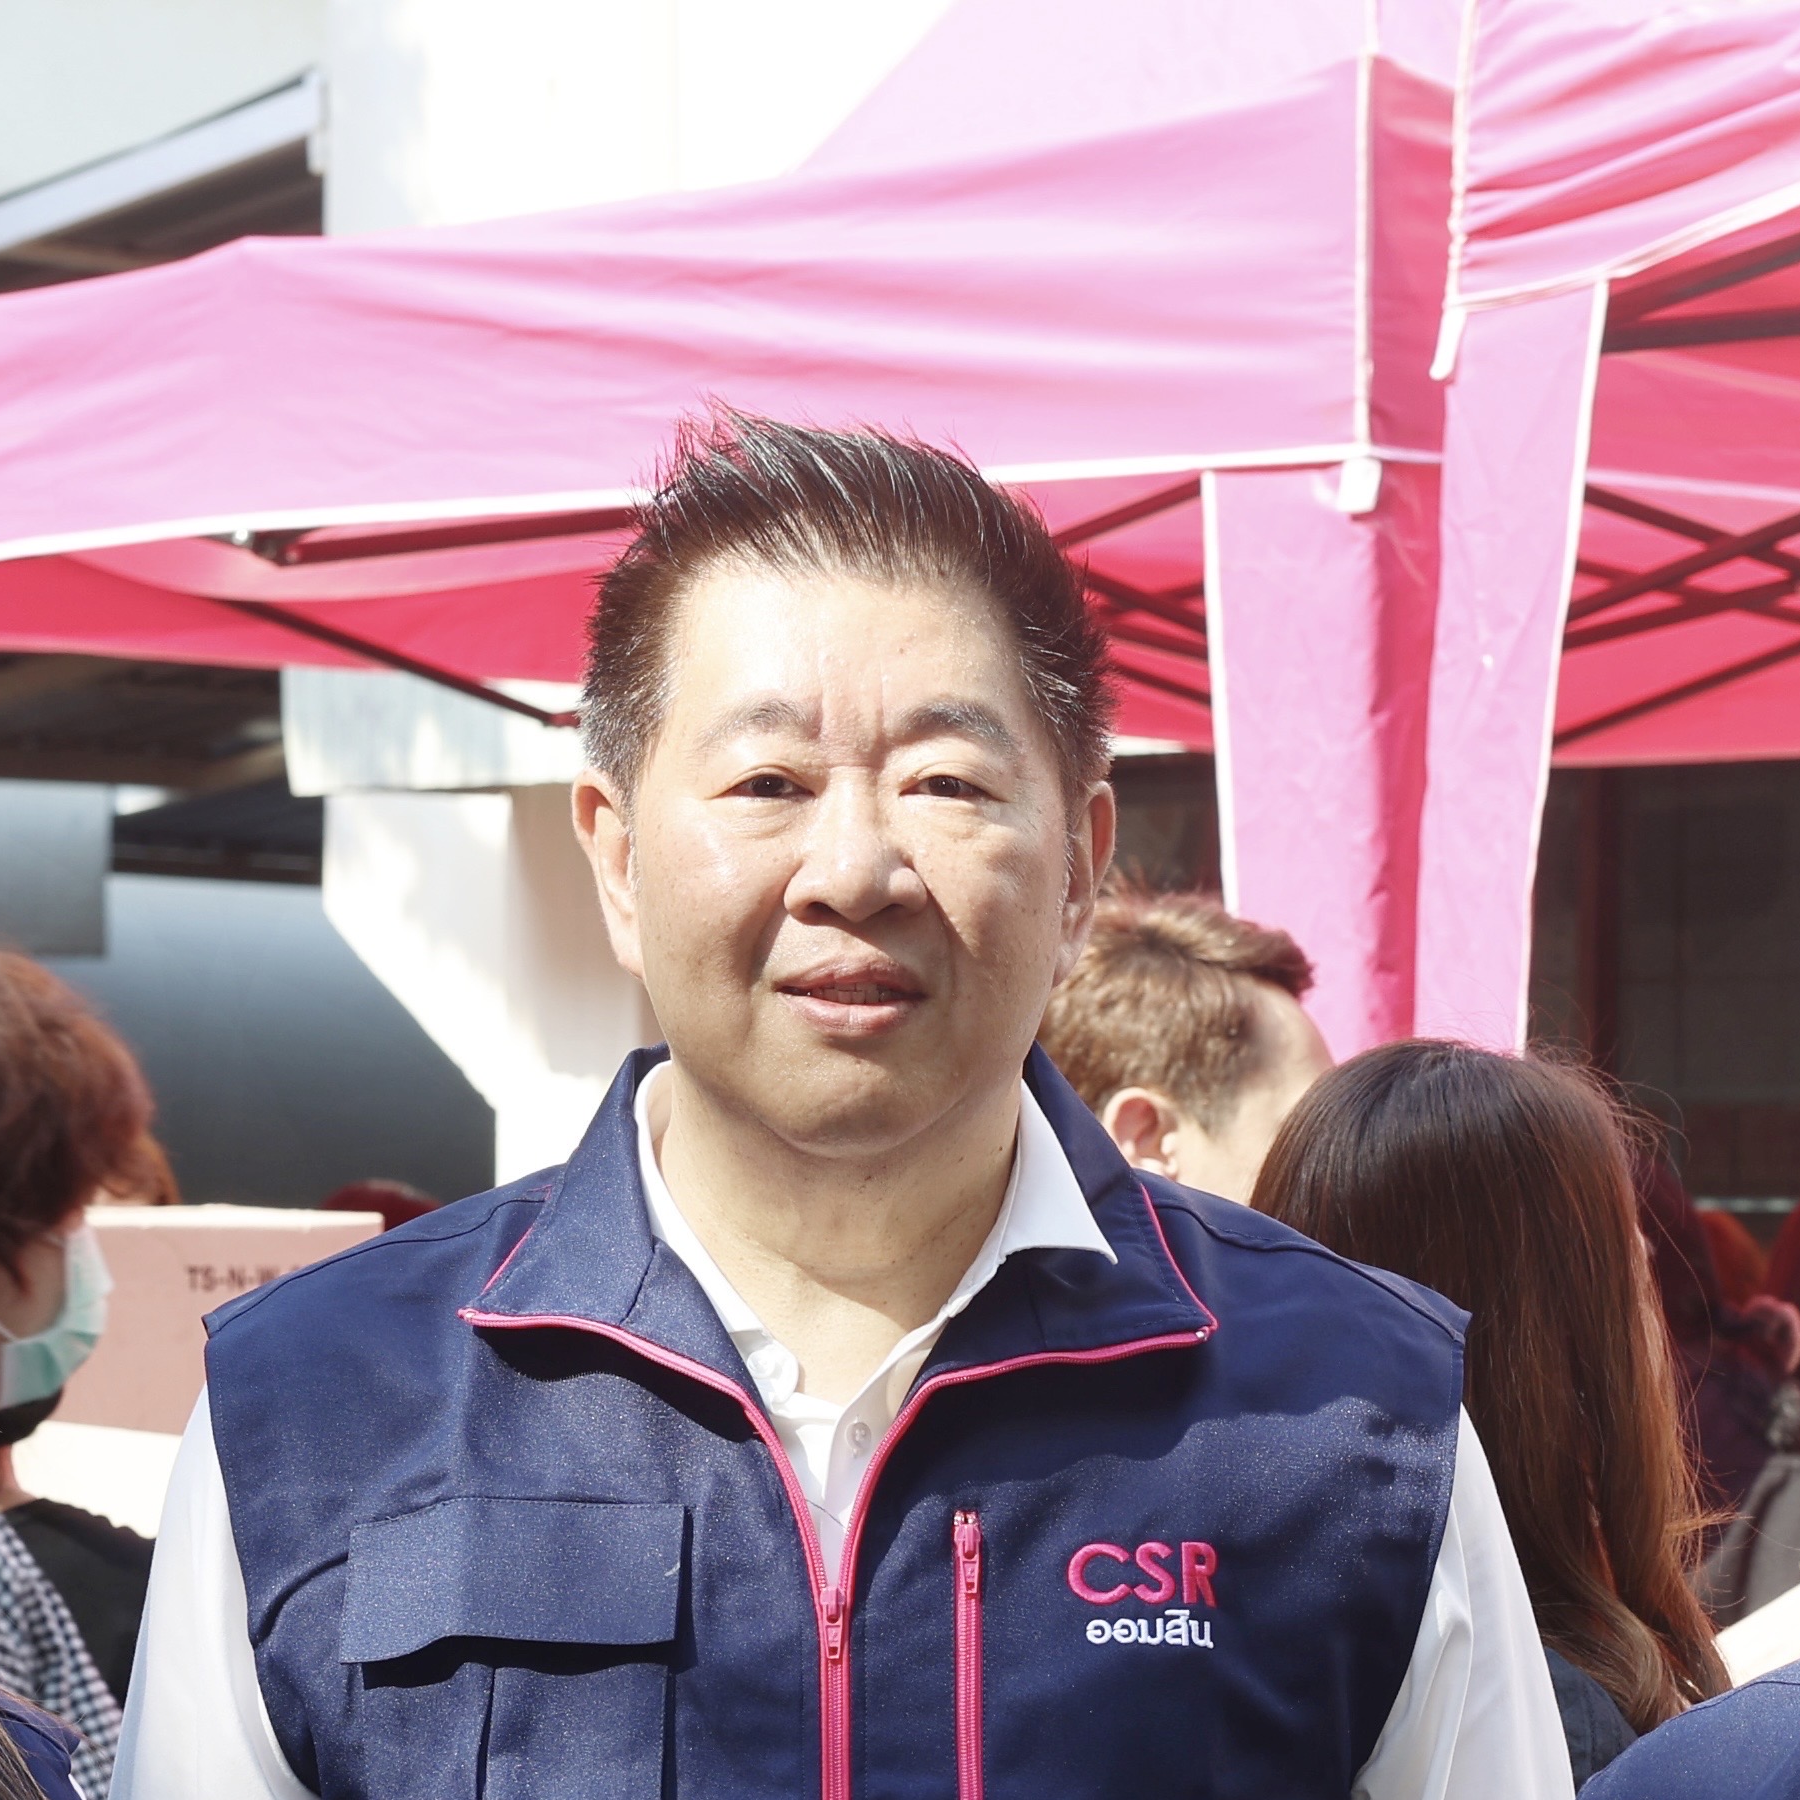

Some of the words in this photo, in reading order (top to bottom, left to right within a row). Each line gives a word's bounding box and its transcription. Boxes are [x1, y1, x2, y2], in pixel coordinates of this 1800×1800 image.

[1067, 1541, 1218, 1608] CSR
[1086, 1609, 1214, 1649] ออมสิน
